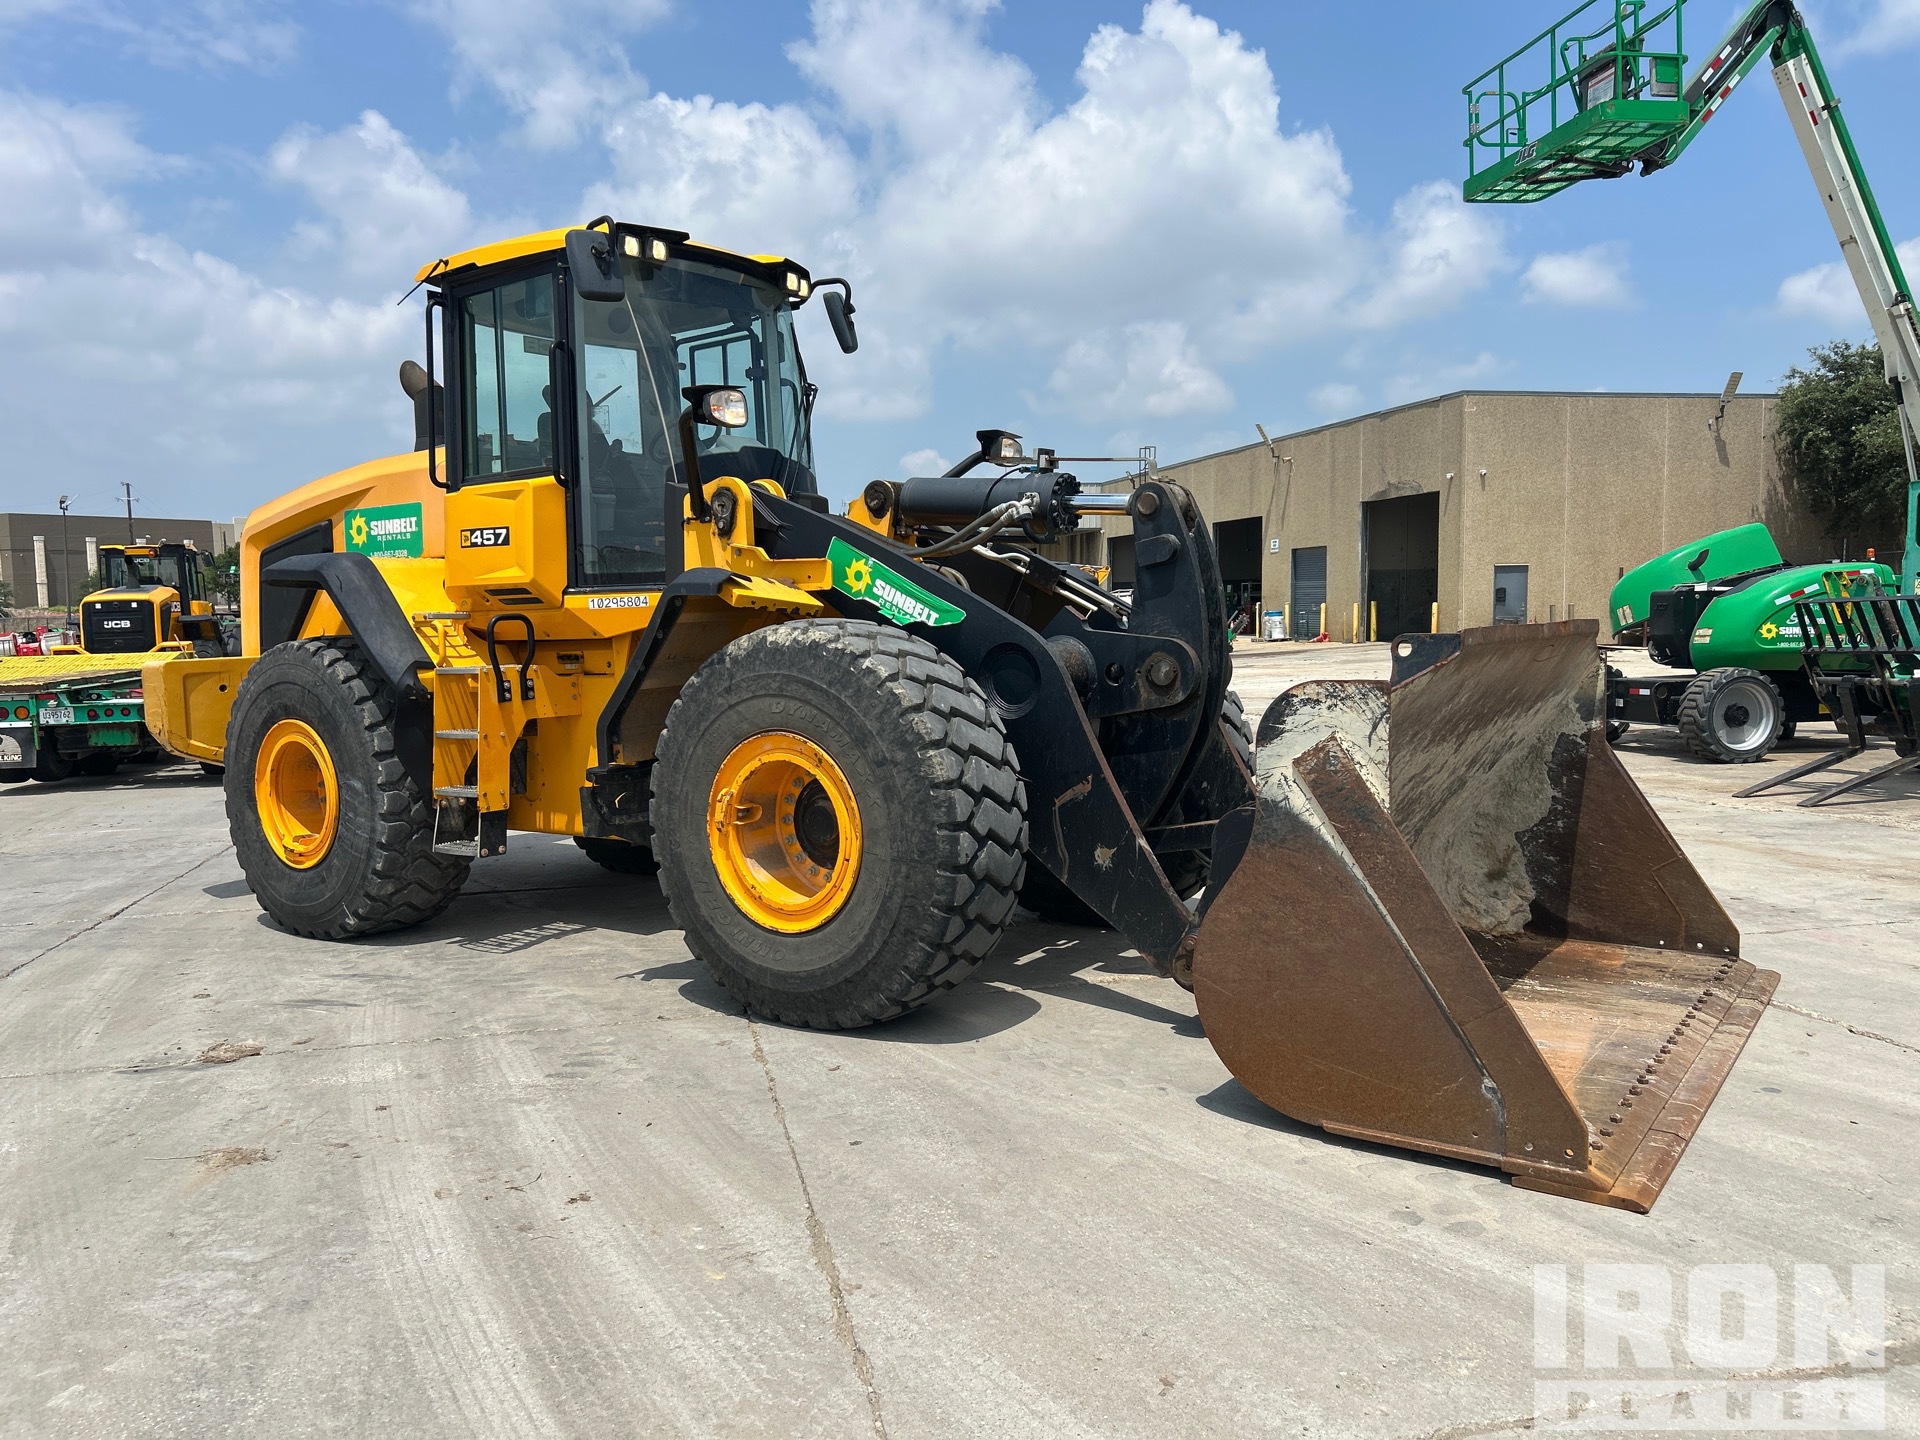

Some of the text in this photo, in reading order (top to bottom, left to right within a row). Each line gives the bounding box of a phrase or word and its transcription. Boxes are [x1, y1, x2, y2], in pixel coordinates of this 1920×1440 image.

[1514, 140, 1538, 167] JLG
[370, 516, 417, 535] SUNBELT
[377, 533, 411, 541] RENTALS
[471, 528, 507, 545] 457
[590, 595, 648, 609] 10295804
[873, 578, 940, 626] SUNBELT
[103, 620, 131, 628] JCB
[43, 710, 71, 719] U395762
